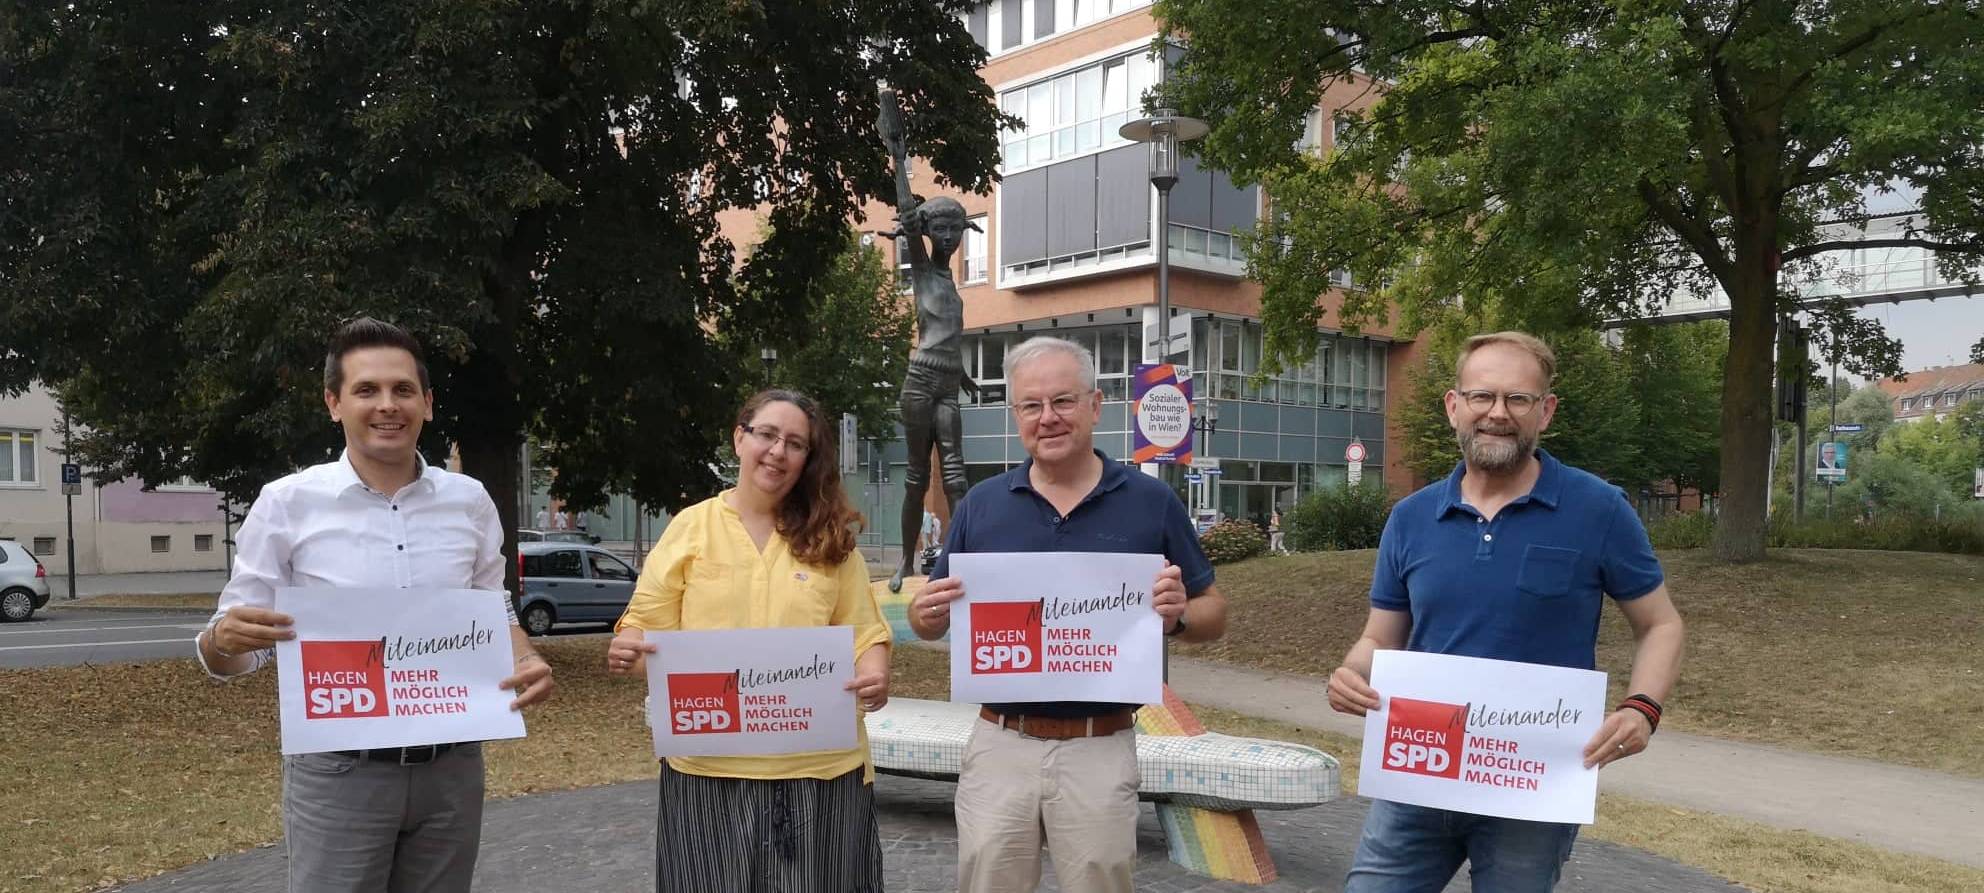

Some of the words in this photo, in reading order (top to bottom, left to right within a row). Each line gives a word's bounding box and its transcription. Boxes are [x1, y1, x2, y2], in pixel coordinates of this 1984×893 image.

[1149, 393, 1182, 403] Sozialer
[1142, 403, 1187, 414] Wohnungs-
[1150, 413, 1165, 422] bau
[1167, 413, 1181, 422] wie
[1149, 423, 1157, 432] in
[1158, 423, 1182, 432] Wien?
[975, 630, 1026, 643] HAGEN
[1047, 628, 1091, 641] MEHR
[1047, 642, 1117, 657] MÖGLICH
[975, 645, 1032, 670] SPD
[1047, 660, 1113, 673] MACHEN
[308, 671, 367, 685] HAGEN
[391, 669, 439, 682] MEHR
[393, 684, 469, 700] MÖGLICH
[310, 687, 377, 714] SPD
[674, 697, 724, 709] HAGEN
[744, 695, 787, 706] MEHR
[395, 702, 467, 717] MACHEN
[745, 706, 813, 719] MÖGLICH
[675, 710, 731, 731] SPD
[746, 721, 809, 732] MACHEN
[1390, 725, 1447, 745] HAGEN
[1469, 736, 1518, 754] MEHR
[1386, 743, 1450, 773] SPD
[1466, 753, 1545, 775] MÖGLICH
[1464, 769, 1539, 791] MACHEN
